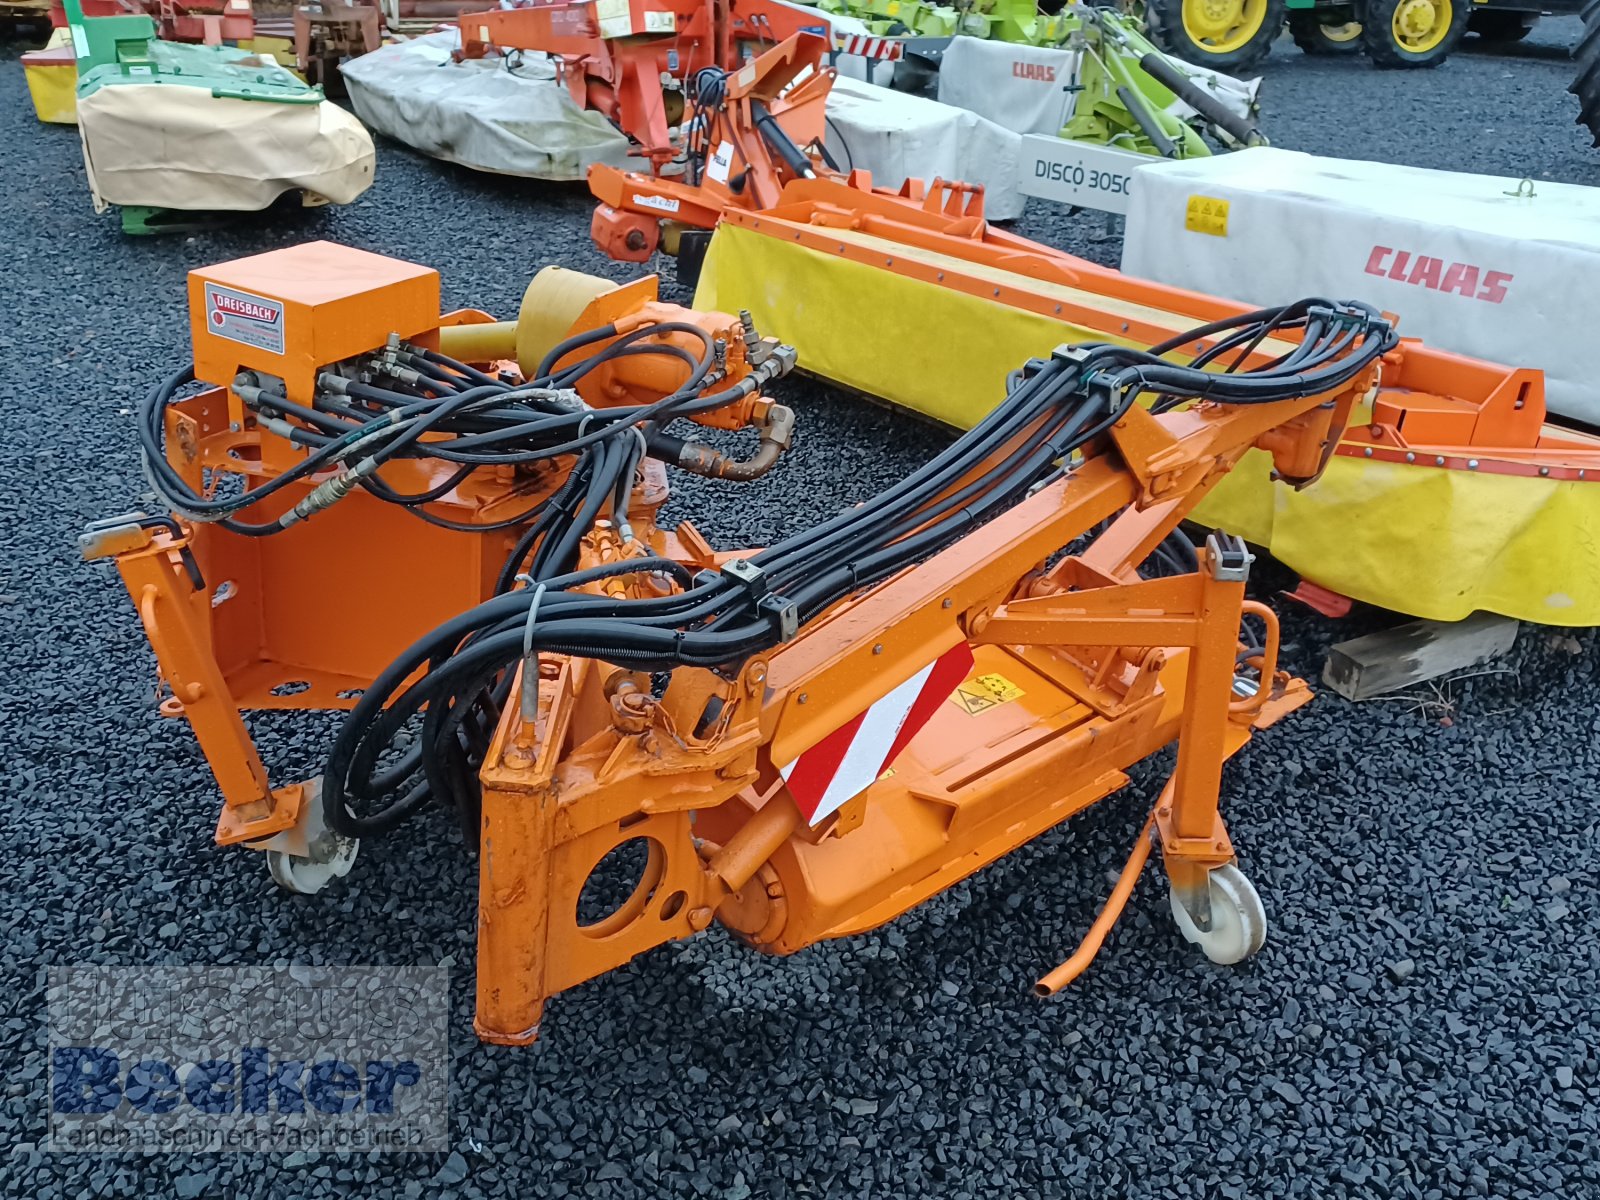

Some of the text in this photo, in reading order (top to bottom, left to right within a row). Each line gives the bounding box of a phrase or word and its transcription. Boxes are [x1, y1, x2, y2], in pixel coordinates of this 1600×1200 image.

[1012, 61, 1056, 82] CLAAS
[1035, 159, 1085, 185] DISCO
[1364, 245, 1514, 304] CLAAS
[216, 295, 272, 320] DREISBACH
